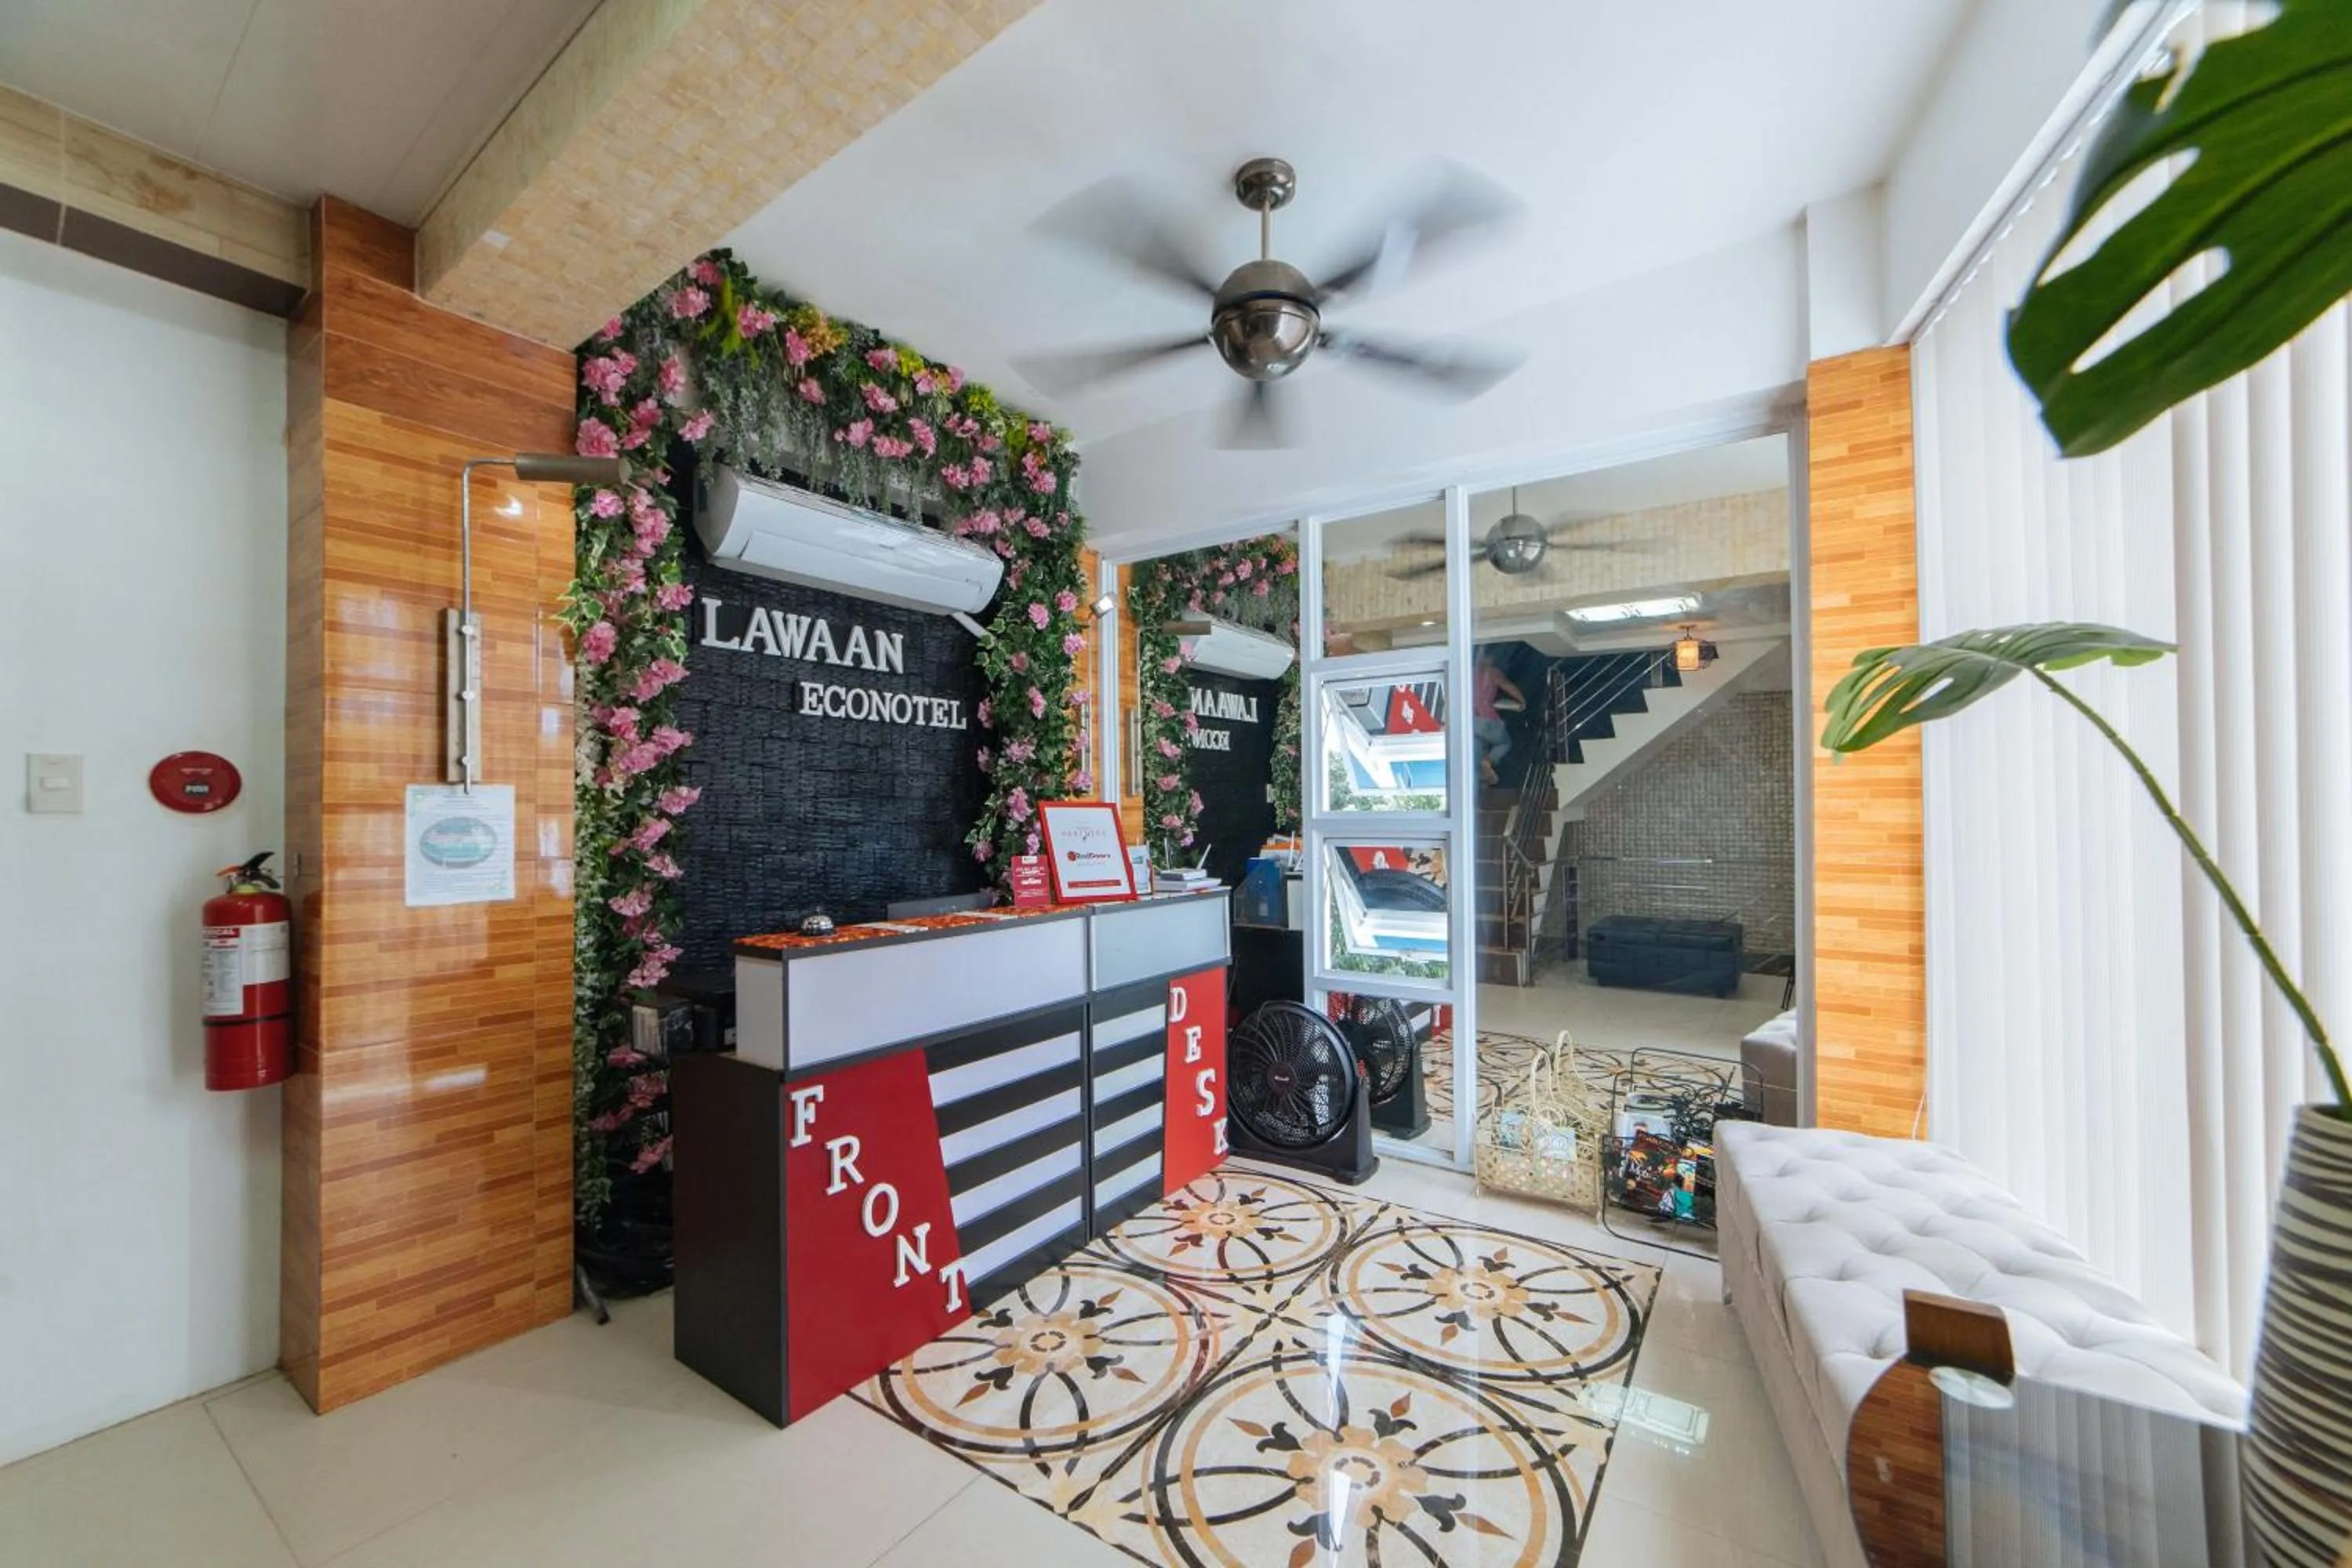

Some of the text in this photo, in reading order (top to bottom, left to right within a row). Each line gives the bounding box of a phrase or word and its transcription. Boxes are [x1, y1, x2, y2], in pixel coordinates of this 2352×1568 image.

[701, 597, 904, 674] LAWAAN
[800, 681, 967, 731] ECONOTEL
[1169, 986, 1229, 1156] DESK
[790, 1084, 966, 1314] FRONT
